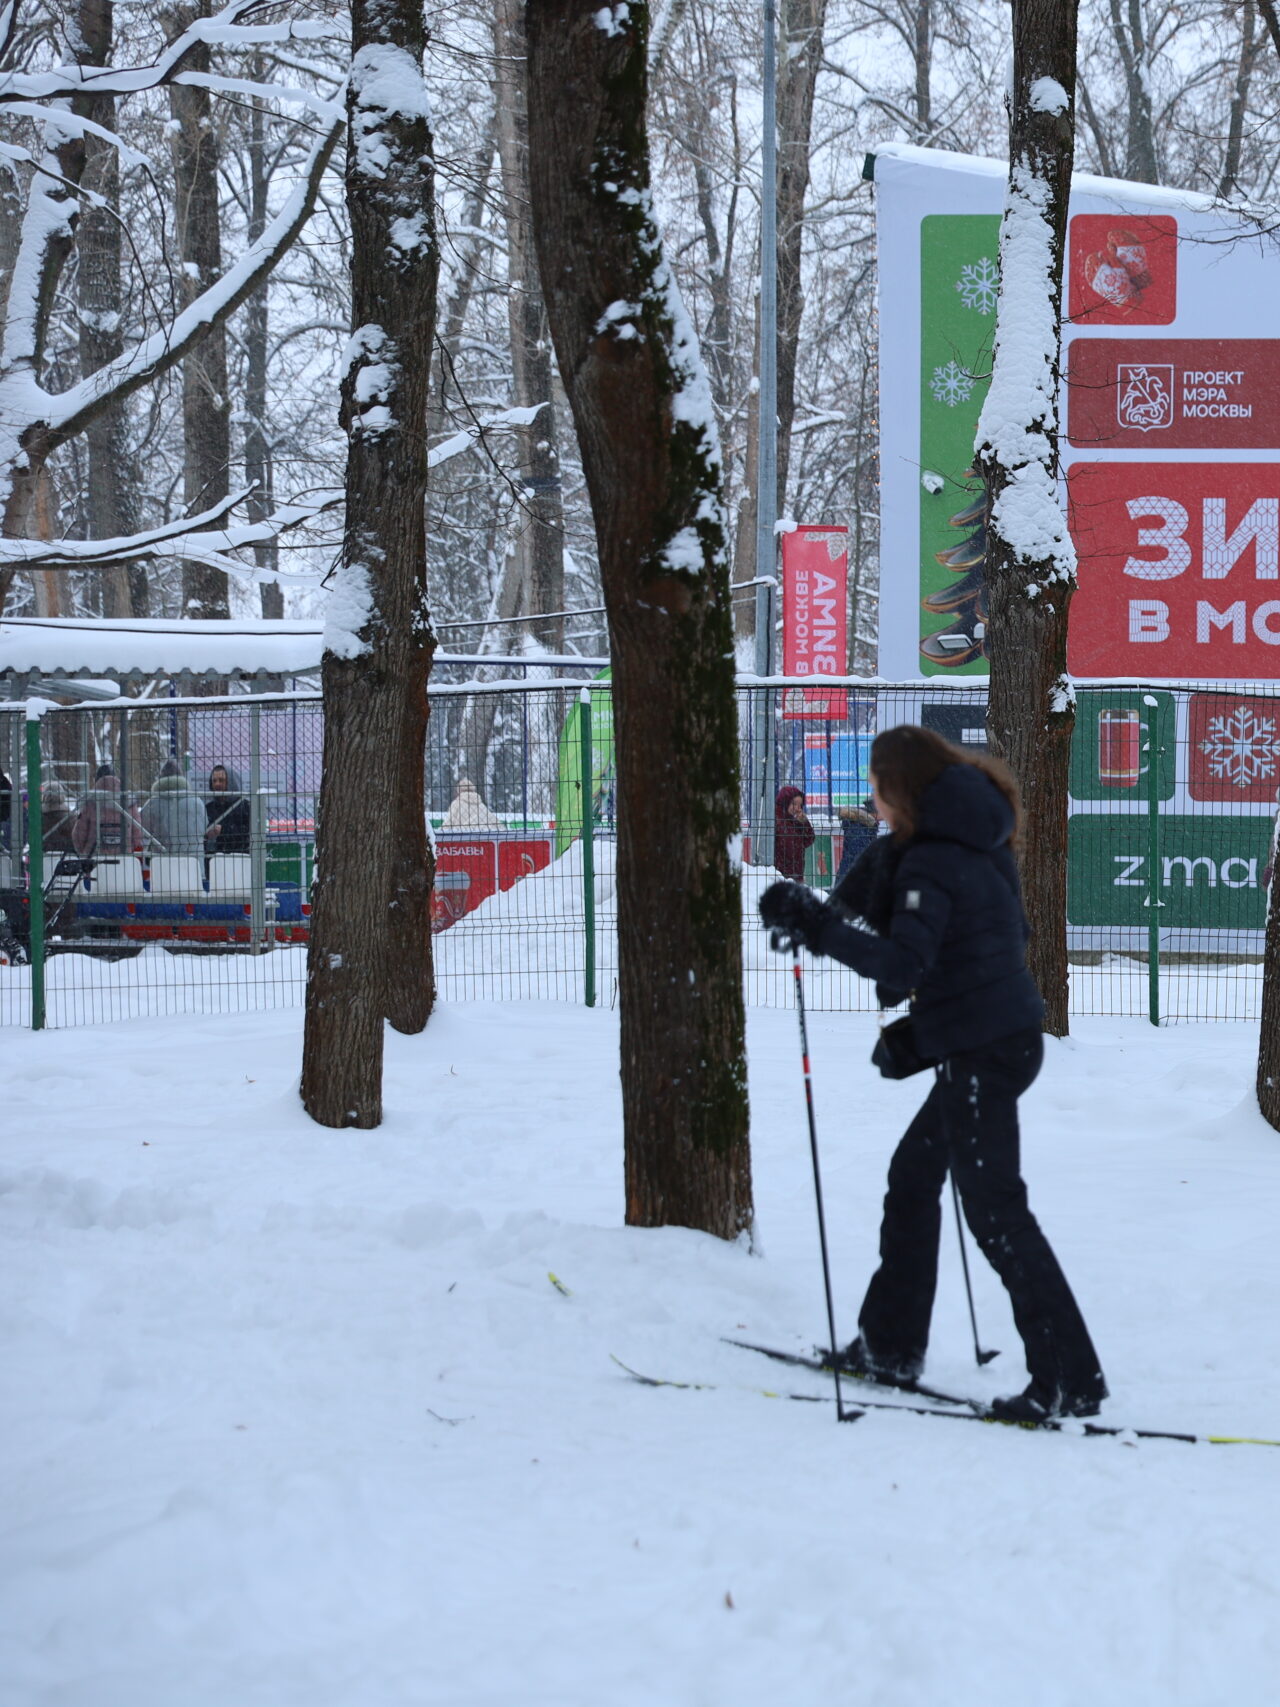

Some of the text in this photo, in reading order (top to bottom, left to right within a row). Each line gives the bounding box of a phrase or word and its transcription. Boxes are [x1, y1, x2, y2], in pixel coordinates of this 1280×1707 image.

[1183, 371, 1245, 385] ПРОЕКТ
[1183, 387, 1228, 401] МЭРА
[1183, 404, 1252, 418] МОСКВЫ
[1128, 599, 1170, 643] В
